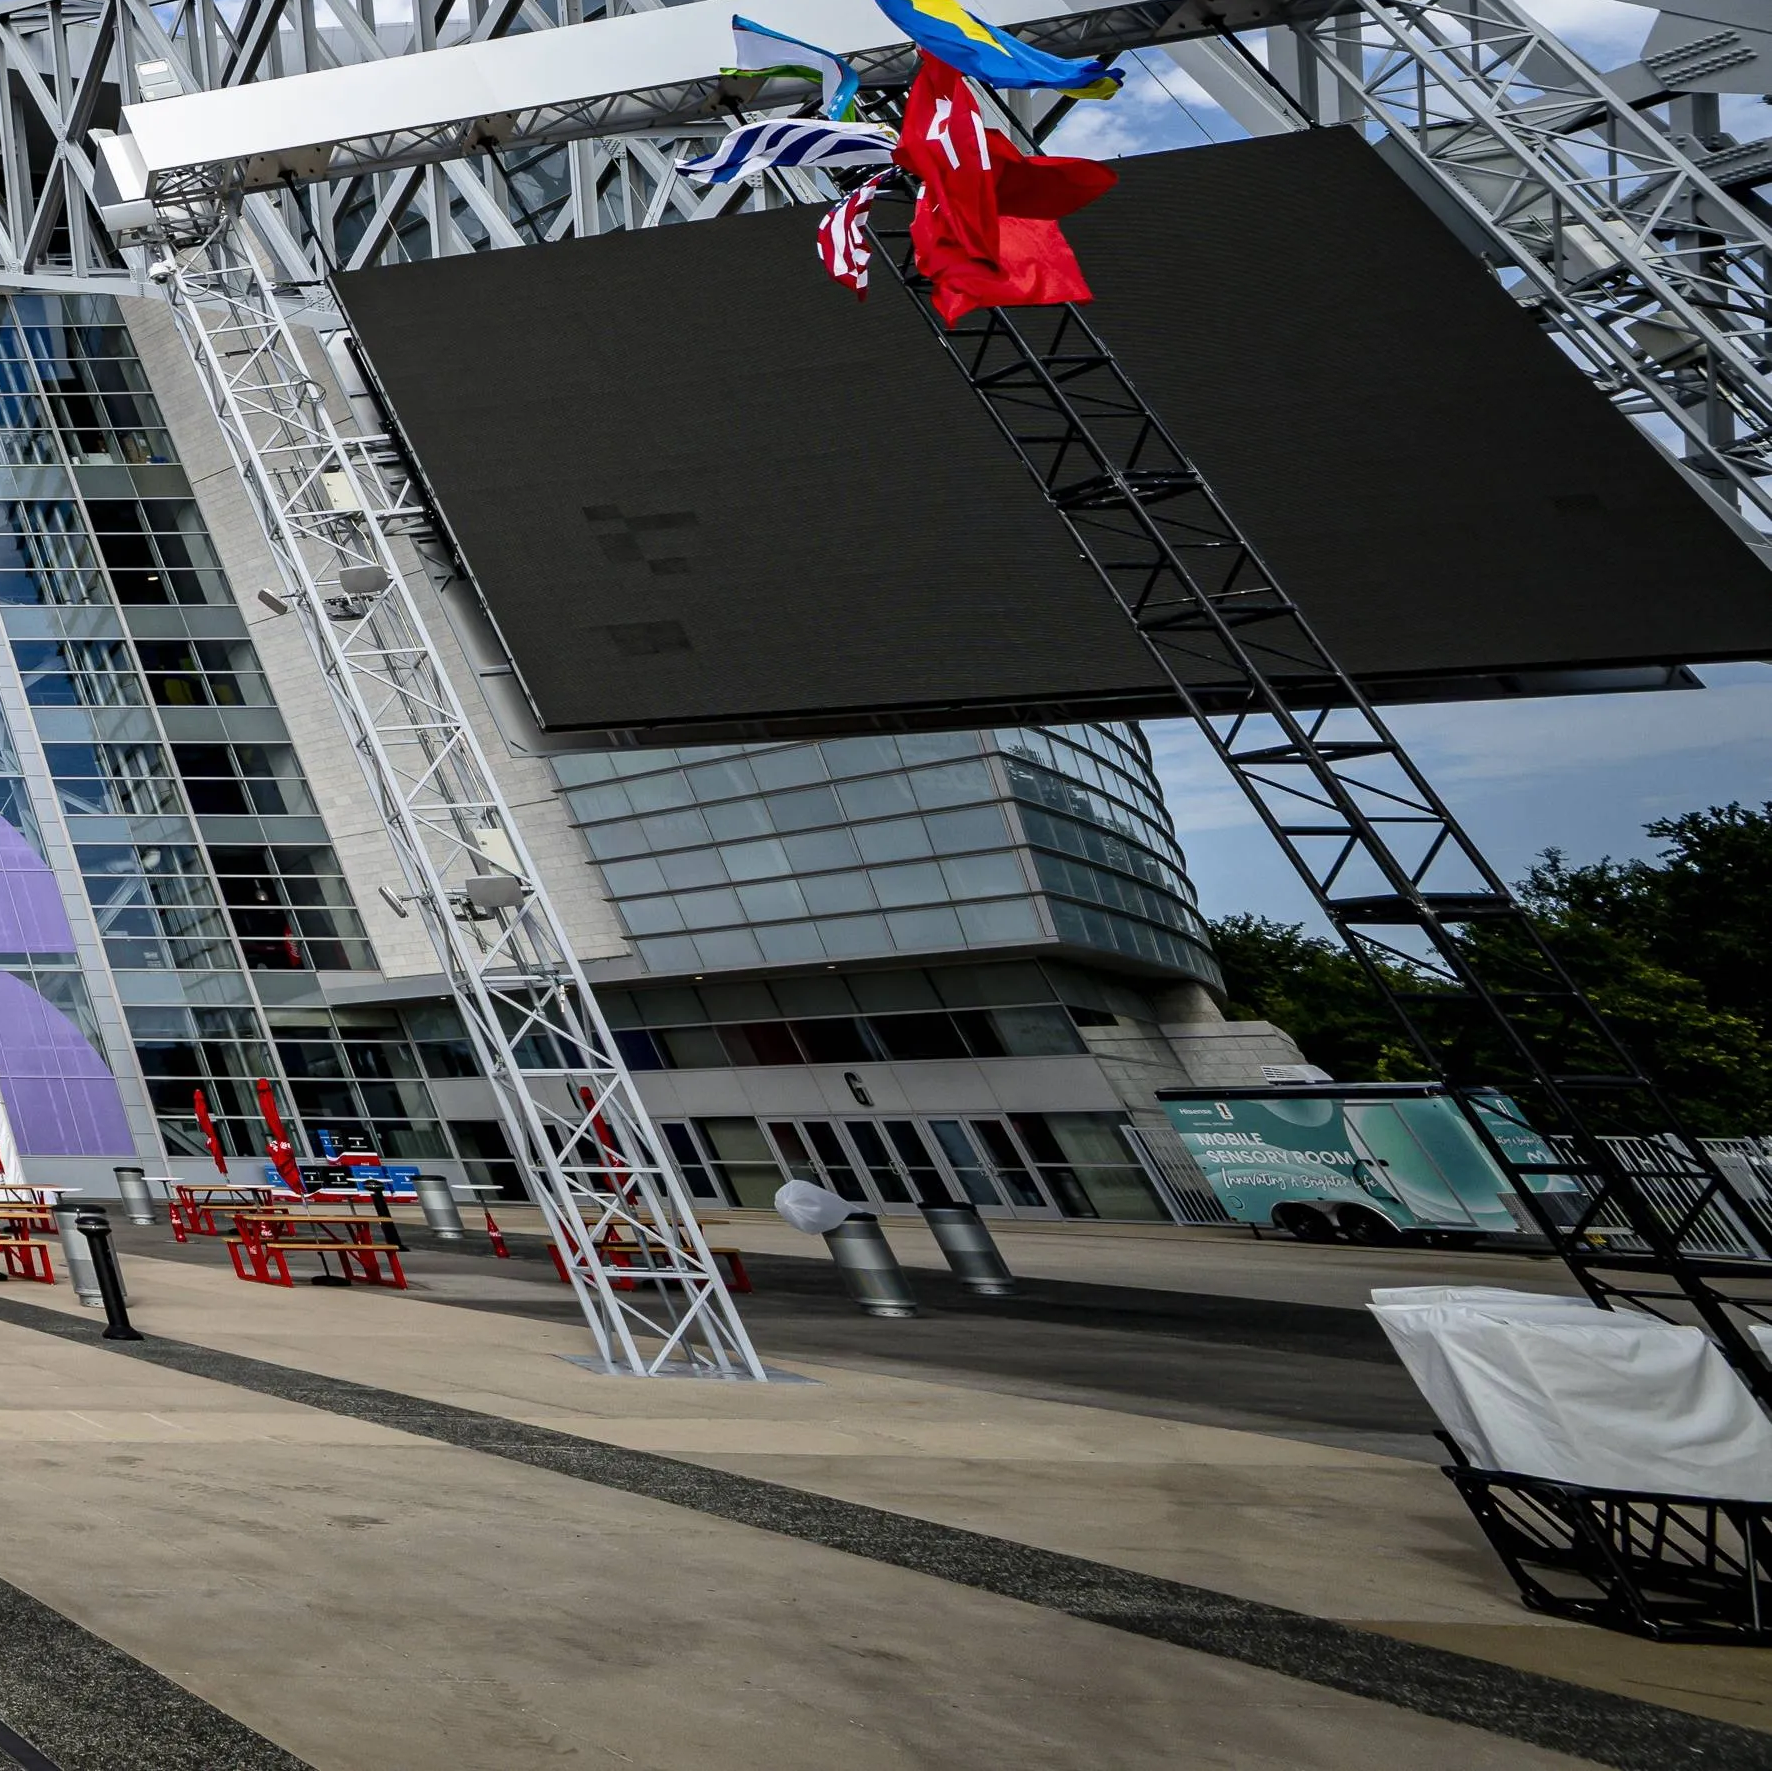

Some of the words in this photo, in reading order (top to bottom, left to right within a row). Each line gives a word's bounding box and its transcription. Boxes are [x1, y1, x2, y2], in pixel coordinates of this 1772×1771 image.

[844, 1071, 874, 1107] G
[1178, 1107, 1213, 1115] Hisense
[1195, 1132, 1266, 1146] MOBILE
[1205, 1150, 1288, 1165] SENSORY
[1293, 1151, 1357, 1165] ROOM
[1221, 1167, 1286, 1191] Innovating
[1302, 1176, 1349, 1191] Brighter
[1350, 1174, 1379, 1192] Lfe
